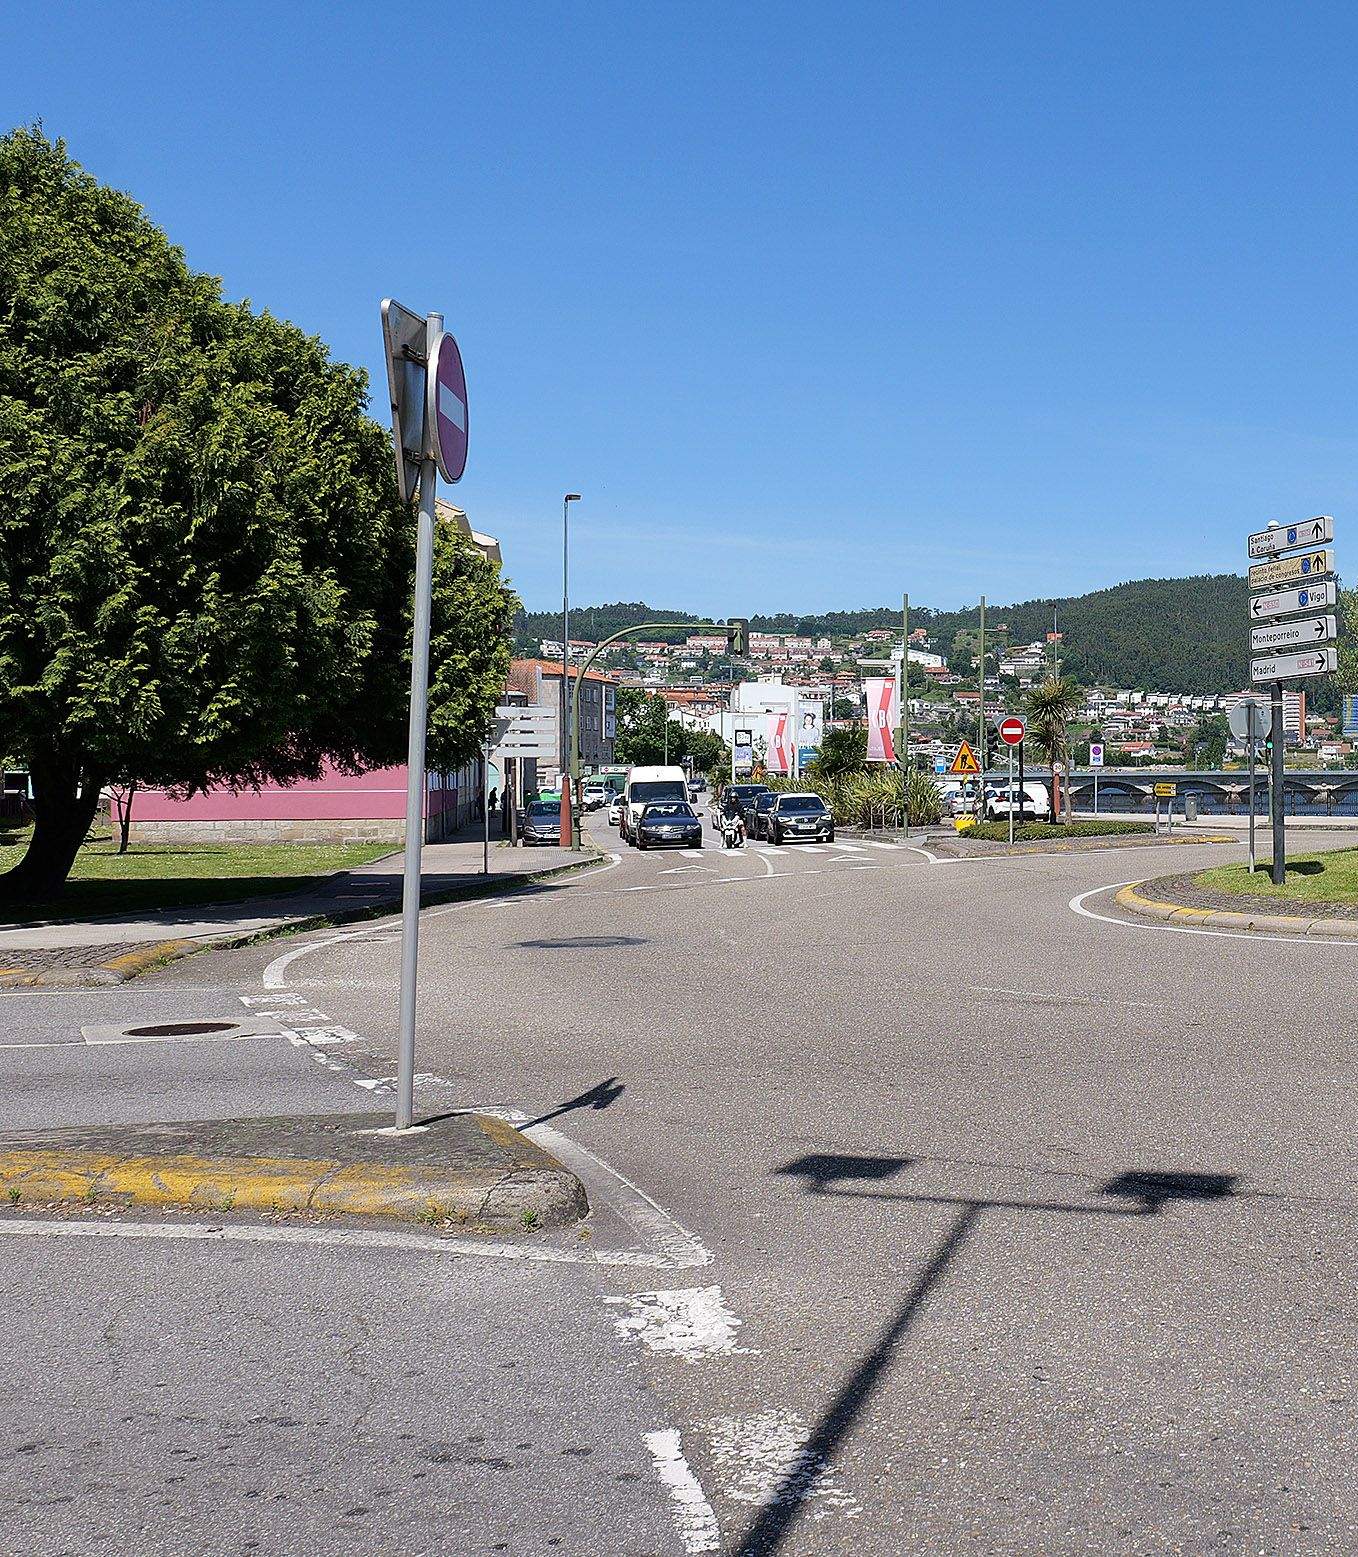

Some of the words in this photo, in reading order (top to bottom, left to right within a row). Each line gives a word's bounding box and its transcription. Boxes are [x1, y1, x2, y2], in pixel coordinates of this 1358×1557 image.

[1251, 534, 1274, 544] Santiago
[1256, 544, 1275, 553] Coruña
[1251, 575, 1268, 584] palacio
[1276, 568, 1300, 579] congresos
[1309, 592, 1325, 602] Vigo
[1252, 629, 1300, 643] Monteporreiro
[1253, 664, 1276, 675] Madrid
